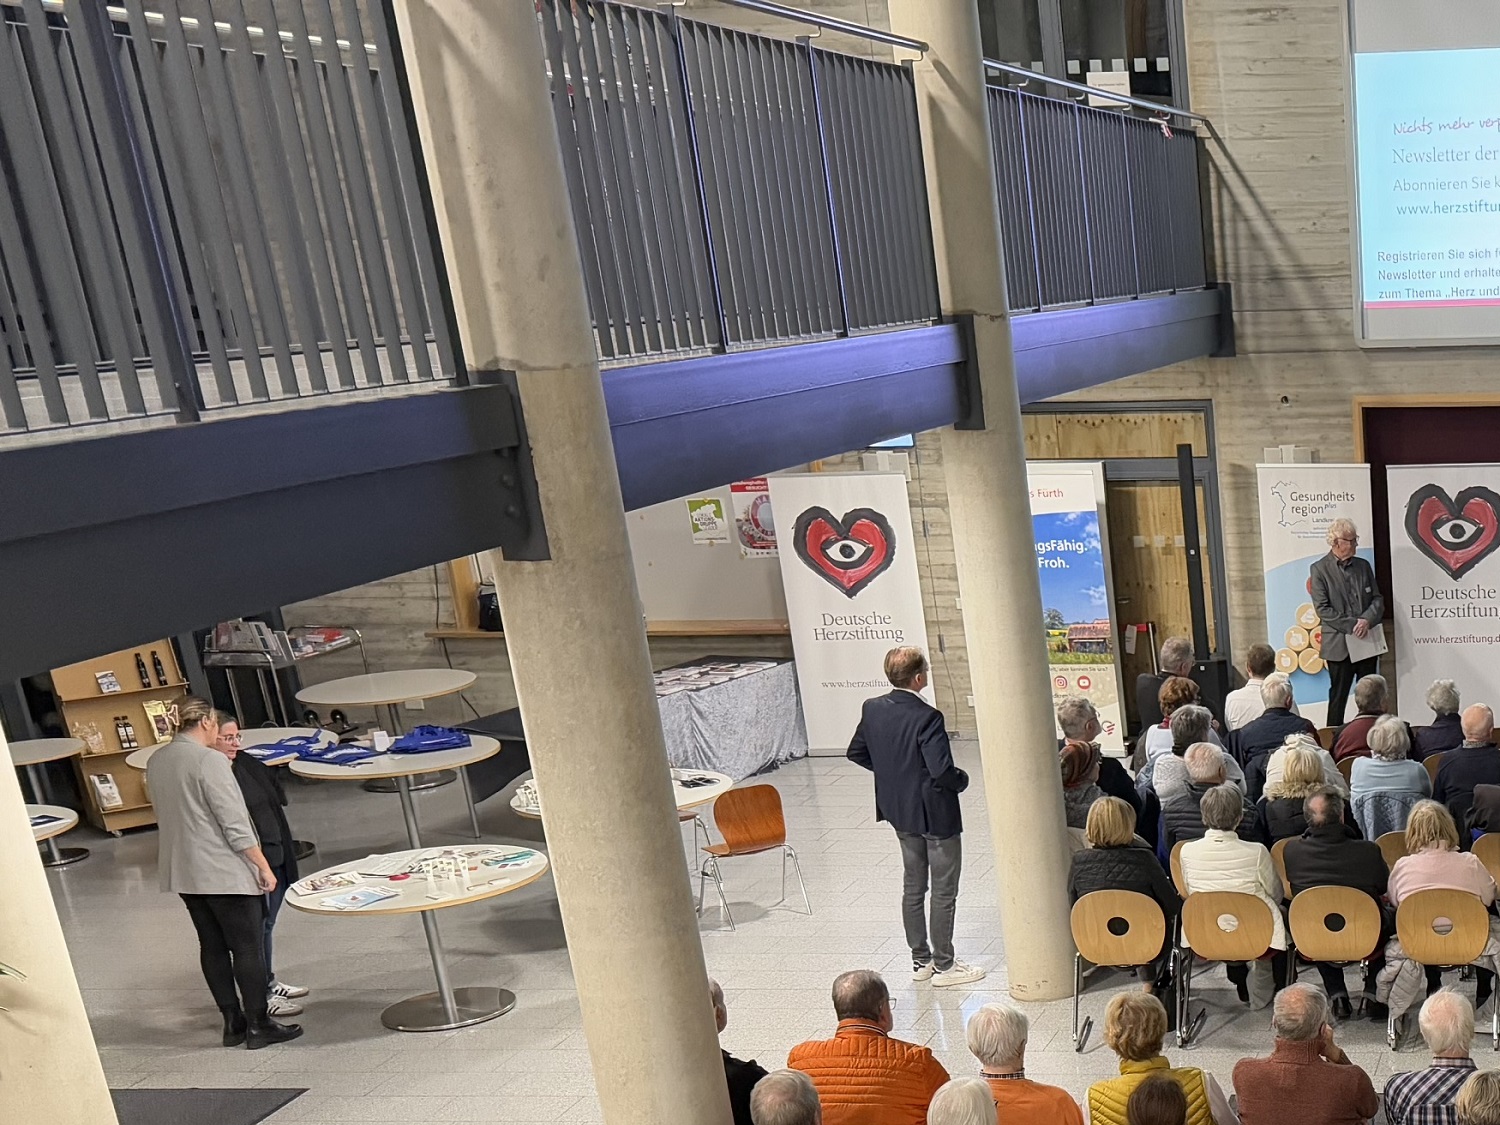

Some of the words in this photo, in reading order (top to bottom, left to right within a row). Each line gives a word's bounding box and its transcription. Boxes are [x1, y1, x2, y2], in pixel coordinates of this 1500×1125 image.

[1393, 117, 1433, 135] Nichts
[1439, 117, 1474, 131] mehr
[1392, 146, 1470, 163] Newsletter
[1475, 145, 1499, 161] der
[1393, 178, 1468, 191] Abonnieren
[1471, 176, 1491, 189] Sie
[1377, 250, 1444, 263] Registrieren
[1448, 249, 1464, 259] Sie
[1468, 248, 1491, 259] sich
[1378, 269, 1436, 280] Newsletter
[1440, 268, 1460, 279] und
[1379, 290, 1401, 299] zum
[1405, 288, 1442, 298] Thema
[1479, 286, 1500, 296] und
[1037, 488, 1064, 498] Fürth
[1290, 491, 1355, 502] Gesundheits
[1038, 556, 1070, 569] Froh.
[1421, 584, 1497, 600] Deutsche
[821, 611, 892, 626] Deutsche
[813, 625, 905, 643] Herzstiftung
